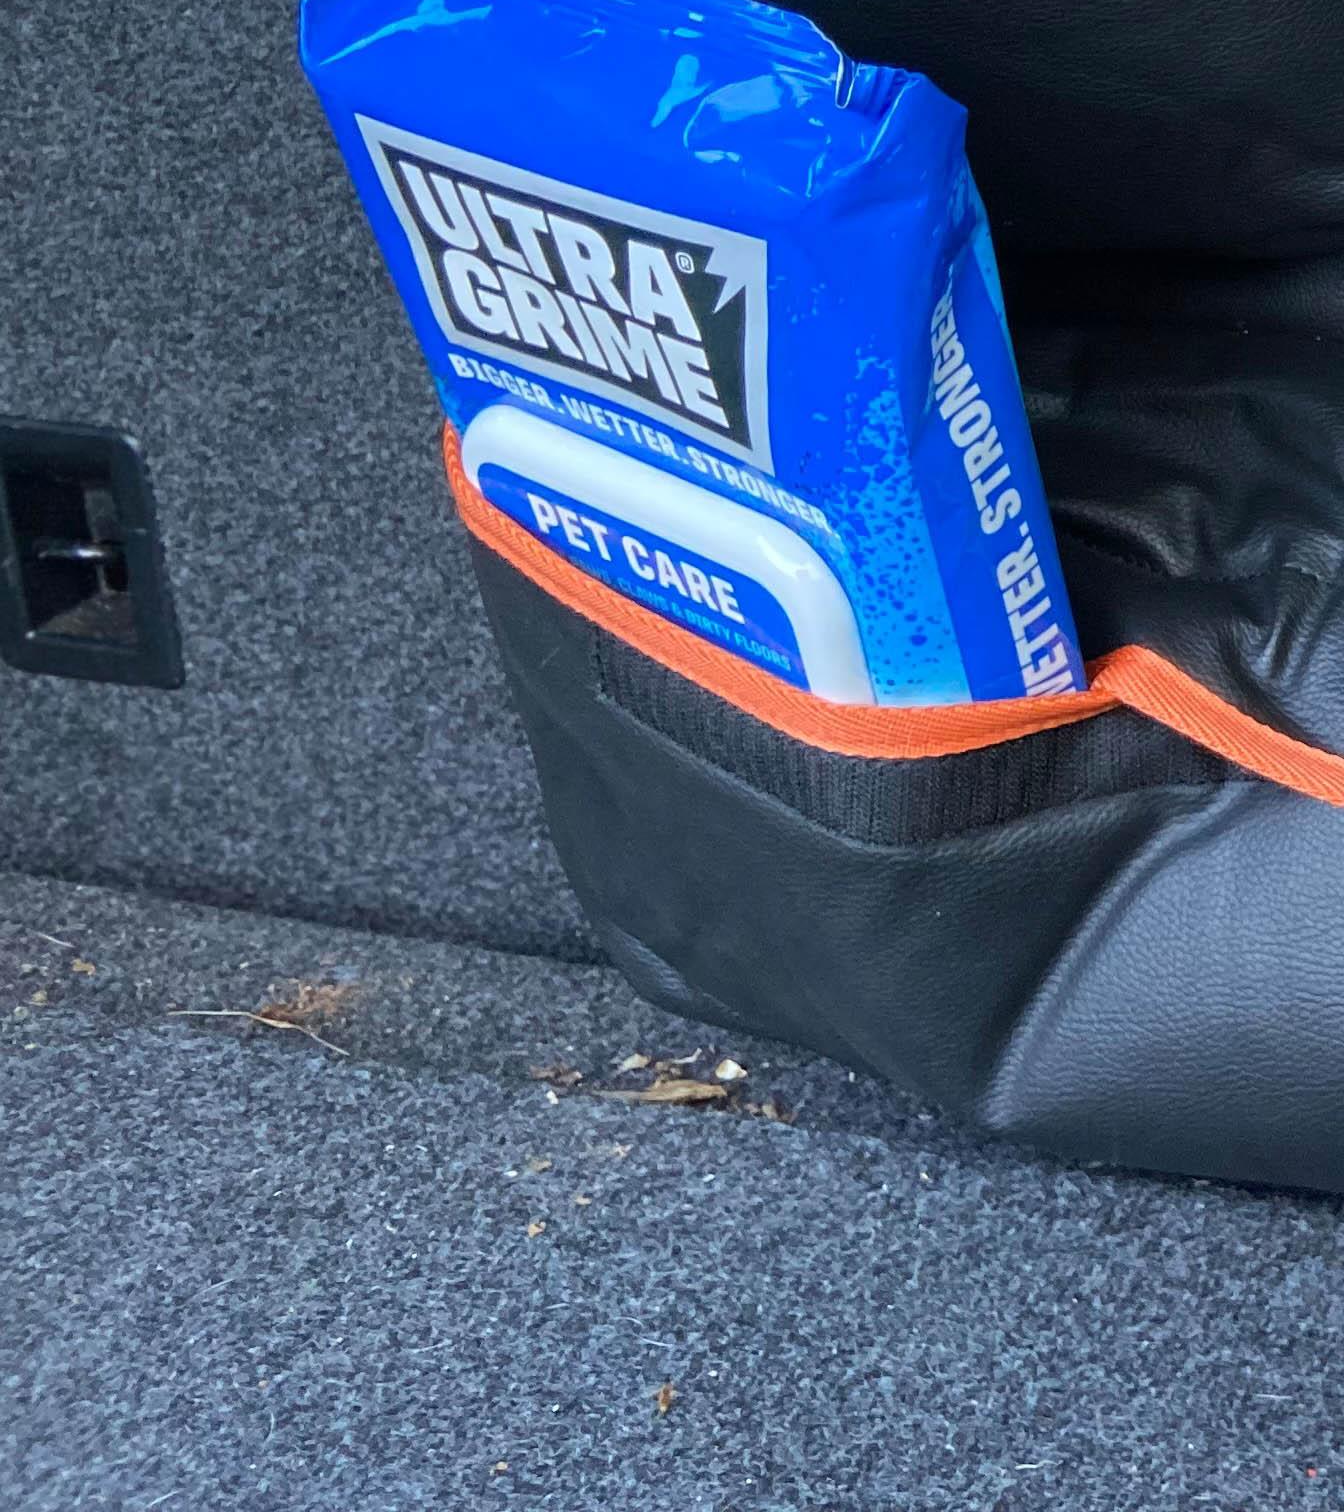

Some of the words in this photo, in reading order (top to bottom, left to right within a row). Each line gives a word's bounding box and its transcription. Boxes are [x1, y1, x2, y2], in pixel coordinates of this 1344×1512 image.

[443, 249, 730, 429] GRIME
[527, 492, 612, 562] PET
[622, 536, 746, 625] CARE
[734, 631, 792, 672] FLOORS
